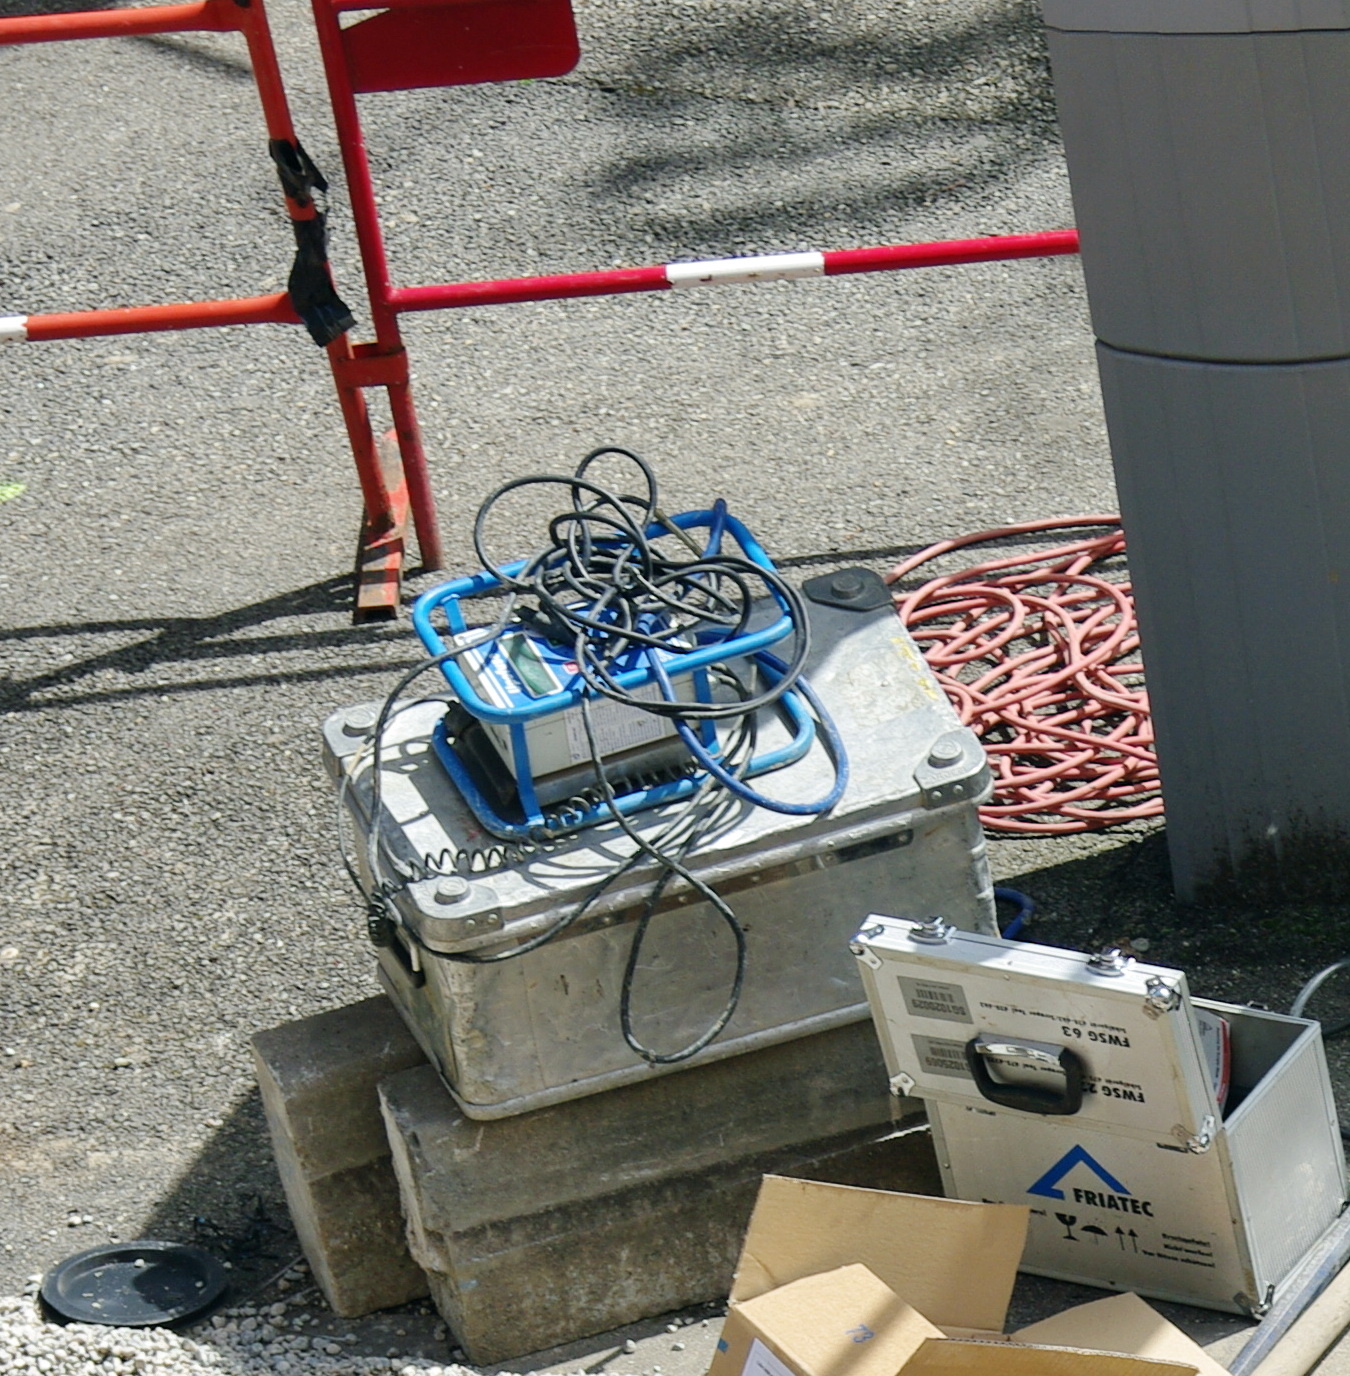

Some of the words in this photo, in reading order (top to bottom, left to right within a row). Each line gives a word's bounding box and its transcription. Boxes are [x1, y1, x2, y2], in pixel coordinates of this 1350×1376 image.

[1062, 1025, 1082, 1038] 63
[1088, 1030, 1131, 1048] FWSG
[1102, 1084, 1145, 1104] FWSG
[1072, 1187, 1154, 1218] FRIATEC
